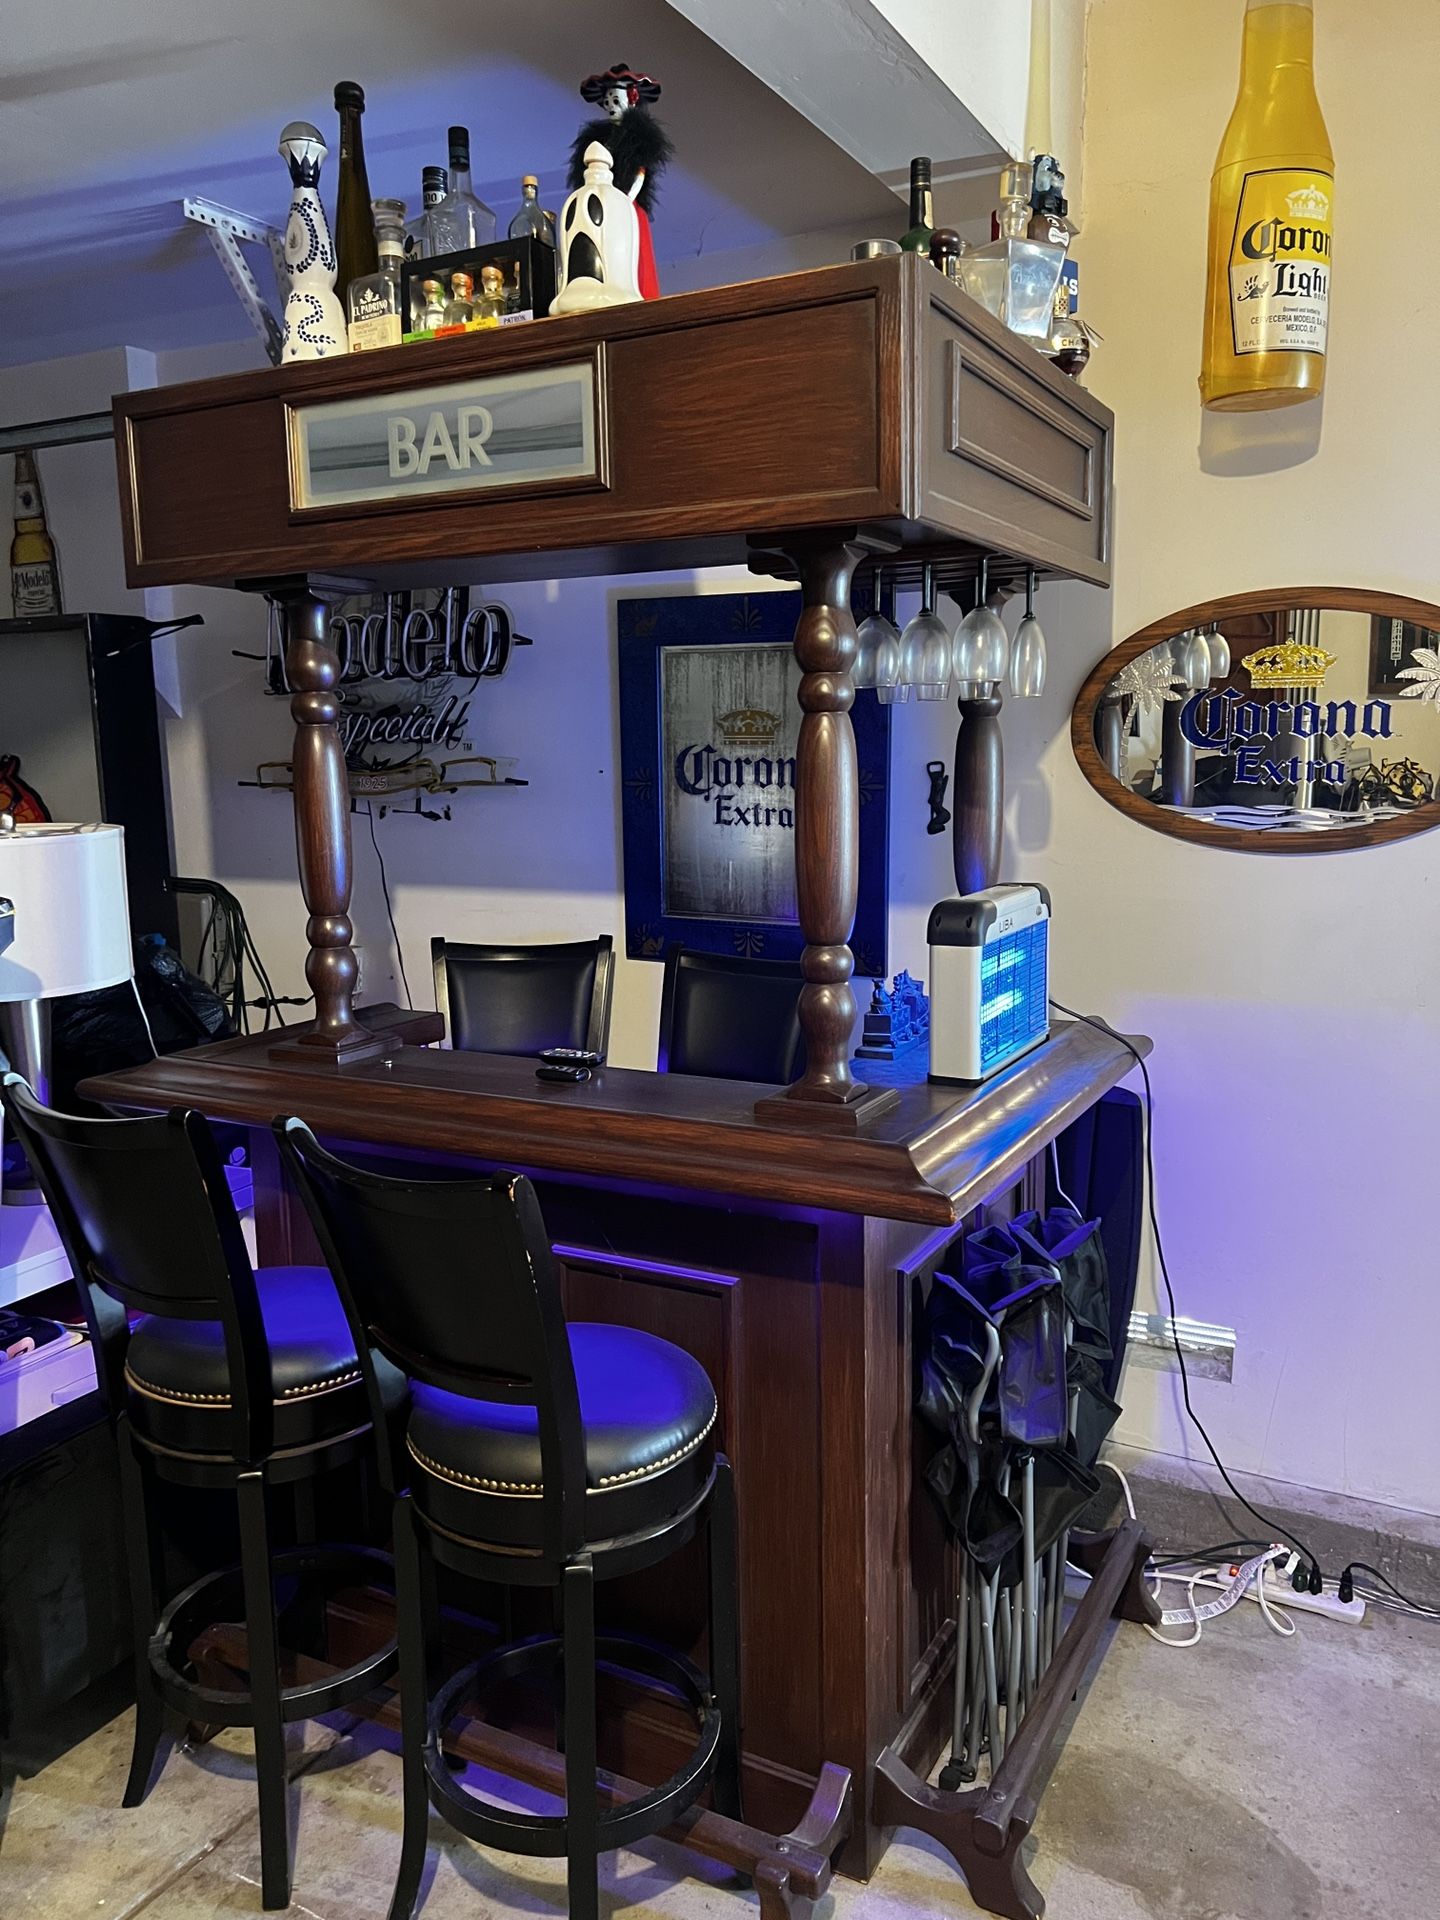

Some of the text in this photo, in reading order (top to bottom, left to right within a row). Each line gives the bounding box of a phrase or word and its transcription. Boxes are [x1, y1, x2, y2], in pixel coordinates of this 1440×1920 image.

[1241, 216, 1332, 262] Coron
[1272, 262, 1327, 298] Light
[361, 299, 388, 314] PADRINO
[1250, 314, 1293, 325] CEVECERIA
[1061, 338, 1083, 347] CHA
[387, 405, 494, 479] BAR
[334, 695, 471, 758] special
[1179, 686, 1393, 757] Corona
[359, 775, 388, 790] 1925
[674, 744, 797, 803] Coron
[1232, 745, 1346, 785] Extra
[713, 795, 795, 828] Extra
[999, 917, 1014, 933] LIBA
